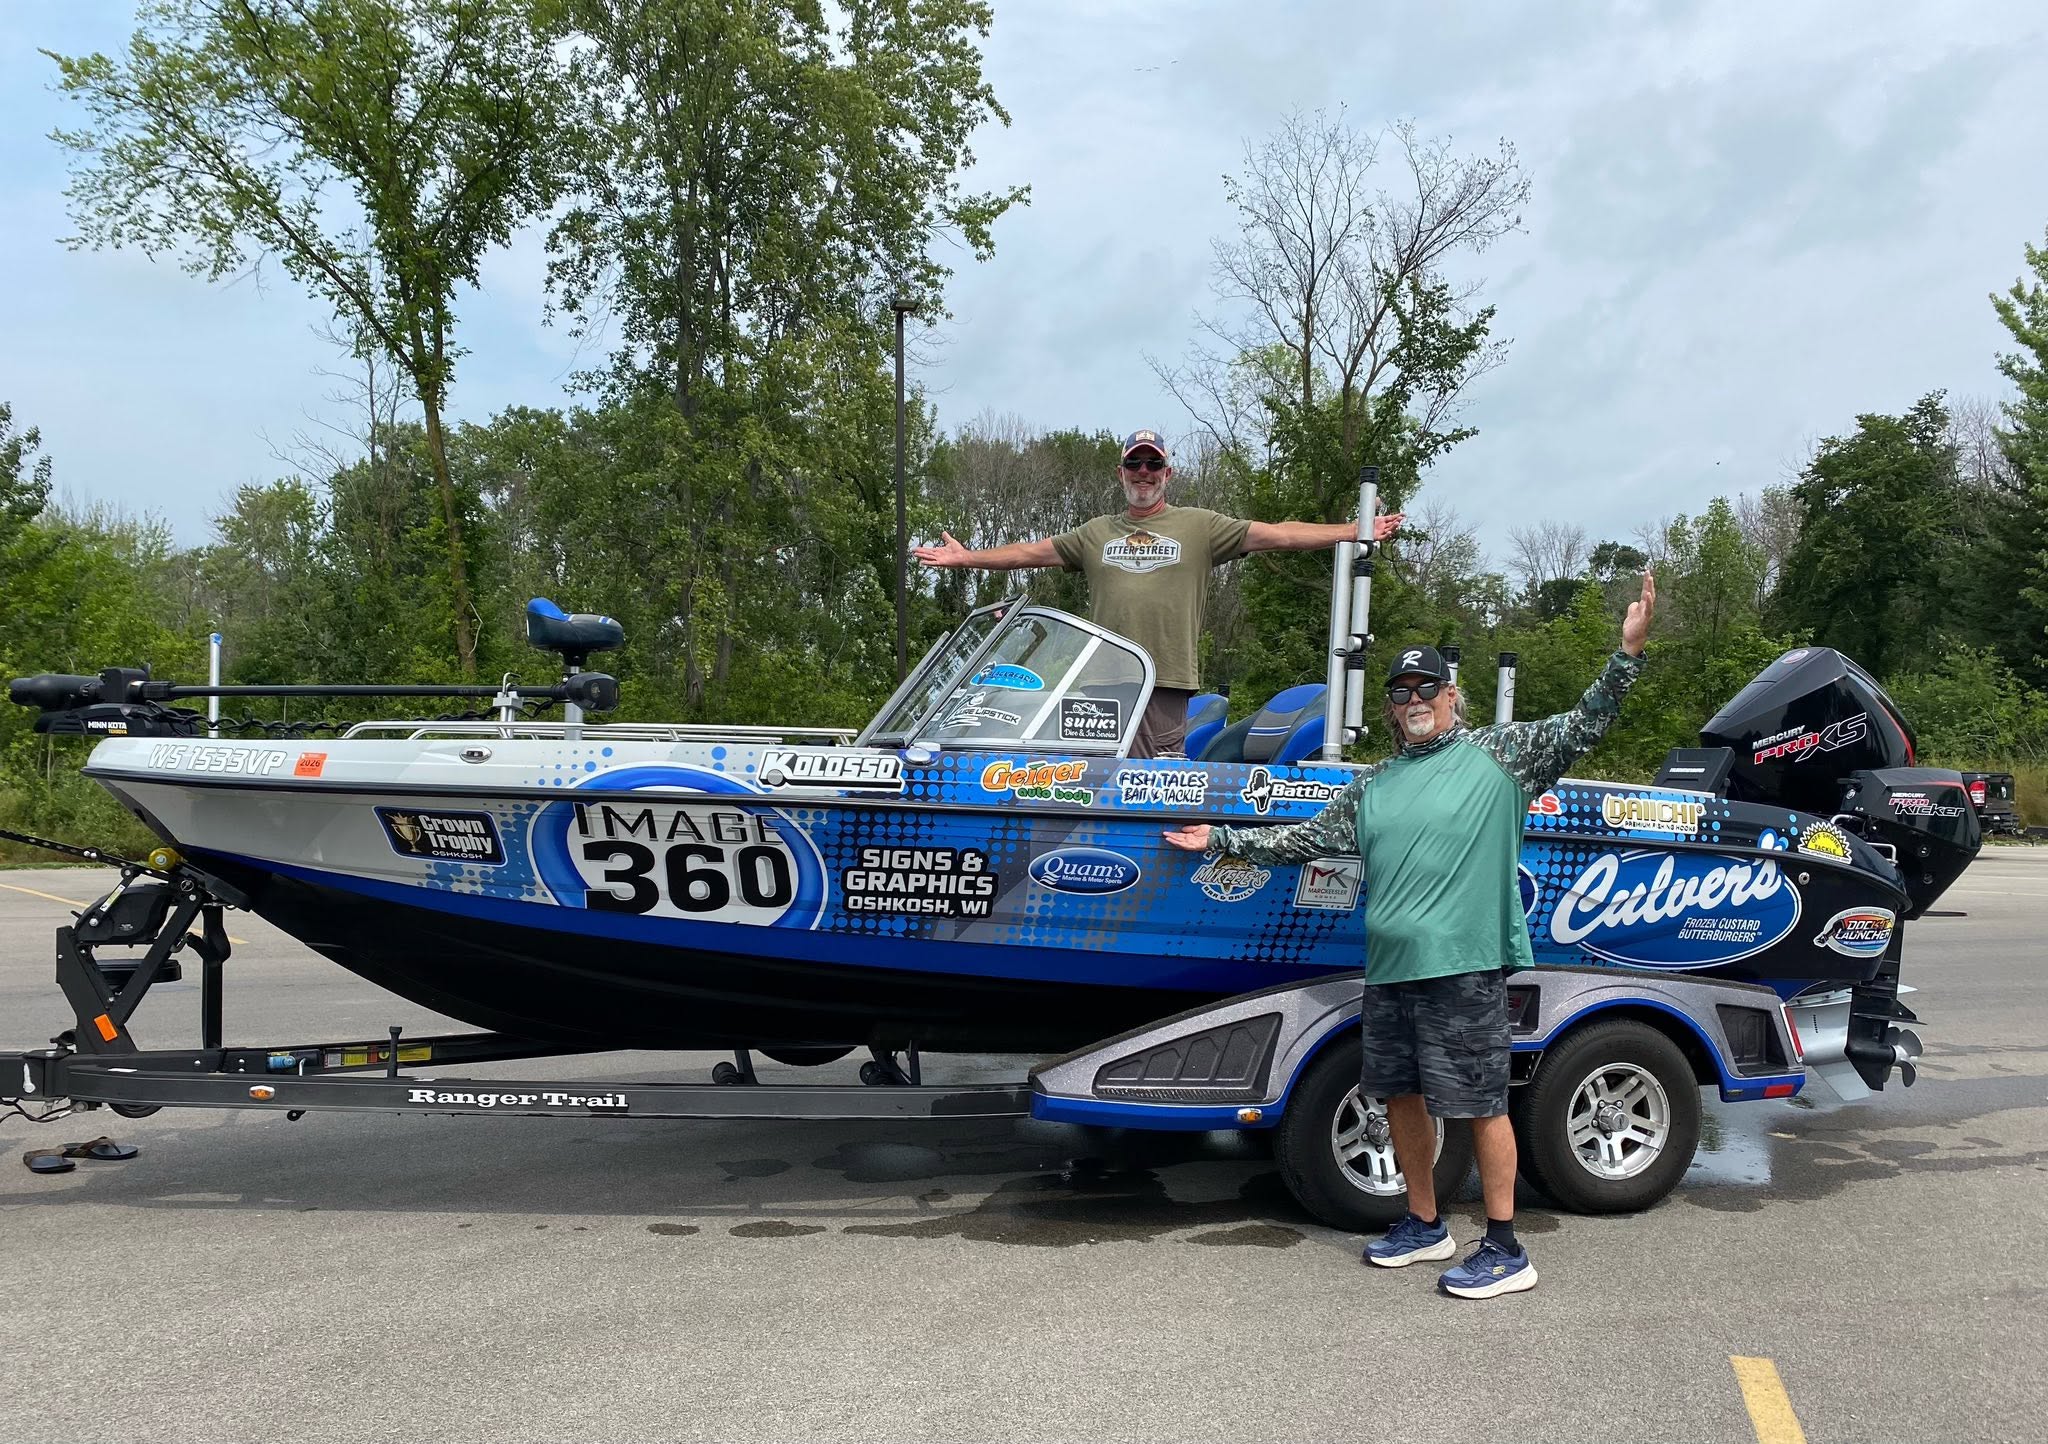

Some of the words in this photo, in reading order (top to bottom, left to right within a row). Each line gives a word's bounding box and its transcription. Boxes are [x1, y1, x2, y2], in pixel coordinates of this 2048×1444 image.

[1107, 546, 1135, 555] OTTER
[1139, 545, 1177, 555] STREET
[1401, 650, 1423, 669] R
[107, 721, 127, 729] KOTA
[975, 709, 1019, 723] LIPSTICK
[1064, 717, 1117, 729] SUNK?
[1079, 729, 1085, 737] &
[1752, 725, 1806, 749] MERCURY
[1754, 732, 1820, 765] PRO
[1794, 712, 1867, 762] XS
[148, 744, 188, 769] WS
[186, 746, 288, 775] 1533VP
[300, 759, 321, 767] 2026
[759, 752, 899, 780] KOLOSSO
[982, 763, 1086, 790] Geiger
[1119, 772, 1157, 787] FISH
[1160, 773, 1206, 788] TALES
[1017, 787, 1052, 798] auto
[1054, 787, 1092, 804] body
[1124, 788, 1148, 801] BAIT
[1162, 789, 1202, 803] TACKLE
[1271, 783, 1329, 799] Battle
[1889, 798, 1930, 806] PRO
[1895, 804, 1965, 817] Kicker
[1608, 798, 1696, 825] DAIICHI
[418, 815, 486, 834] Crown
[573, 802, 784, 845] IMAGE
[1624, 821, 1651, 829] PREMIUM
[1652, 823, 1675, 831] FISHING
[424, 830, 493, 854] Trophy
[1811, 833, 1821, 844] OFF
[1823, 833, 1841, 849] SHORE
[1814, 844, 1837, 854] TACKLE
[431, 851, 483, 860] OSHKOSH
[862, 849, 952, 871] SIGNS
[961, 852, 984, 872] &
[1042, 856, 1126, 878] Quam's
[583, 840, 792, 915] 360
[846, 870, 993, 895] GRAPHICS
[1061, 874, 1081, 882] Marine
[1310, 867, 1348, 888] MK
[1551, 833, 1783, 944] Culver's
[848, 896, 955, 915] OSHKOSH,
[961, 900, 989, 915] WI
[1683, 917, 1718, 929] FROZEN
[1718, 918, 1761, 931] CUSTARD
[408, 1089, 537, 1108] Ranger
[542, 1093, 629, 1107] Trail
